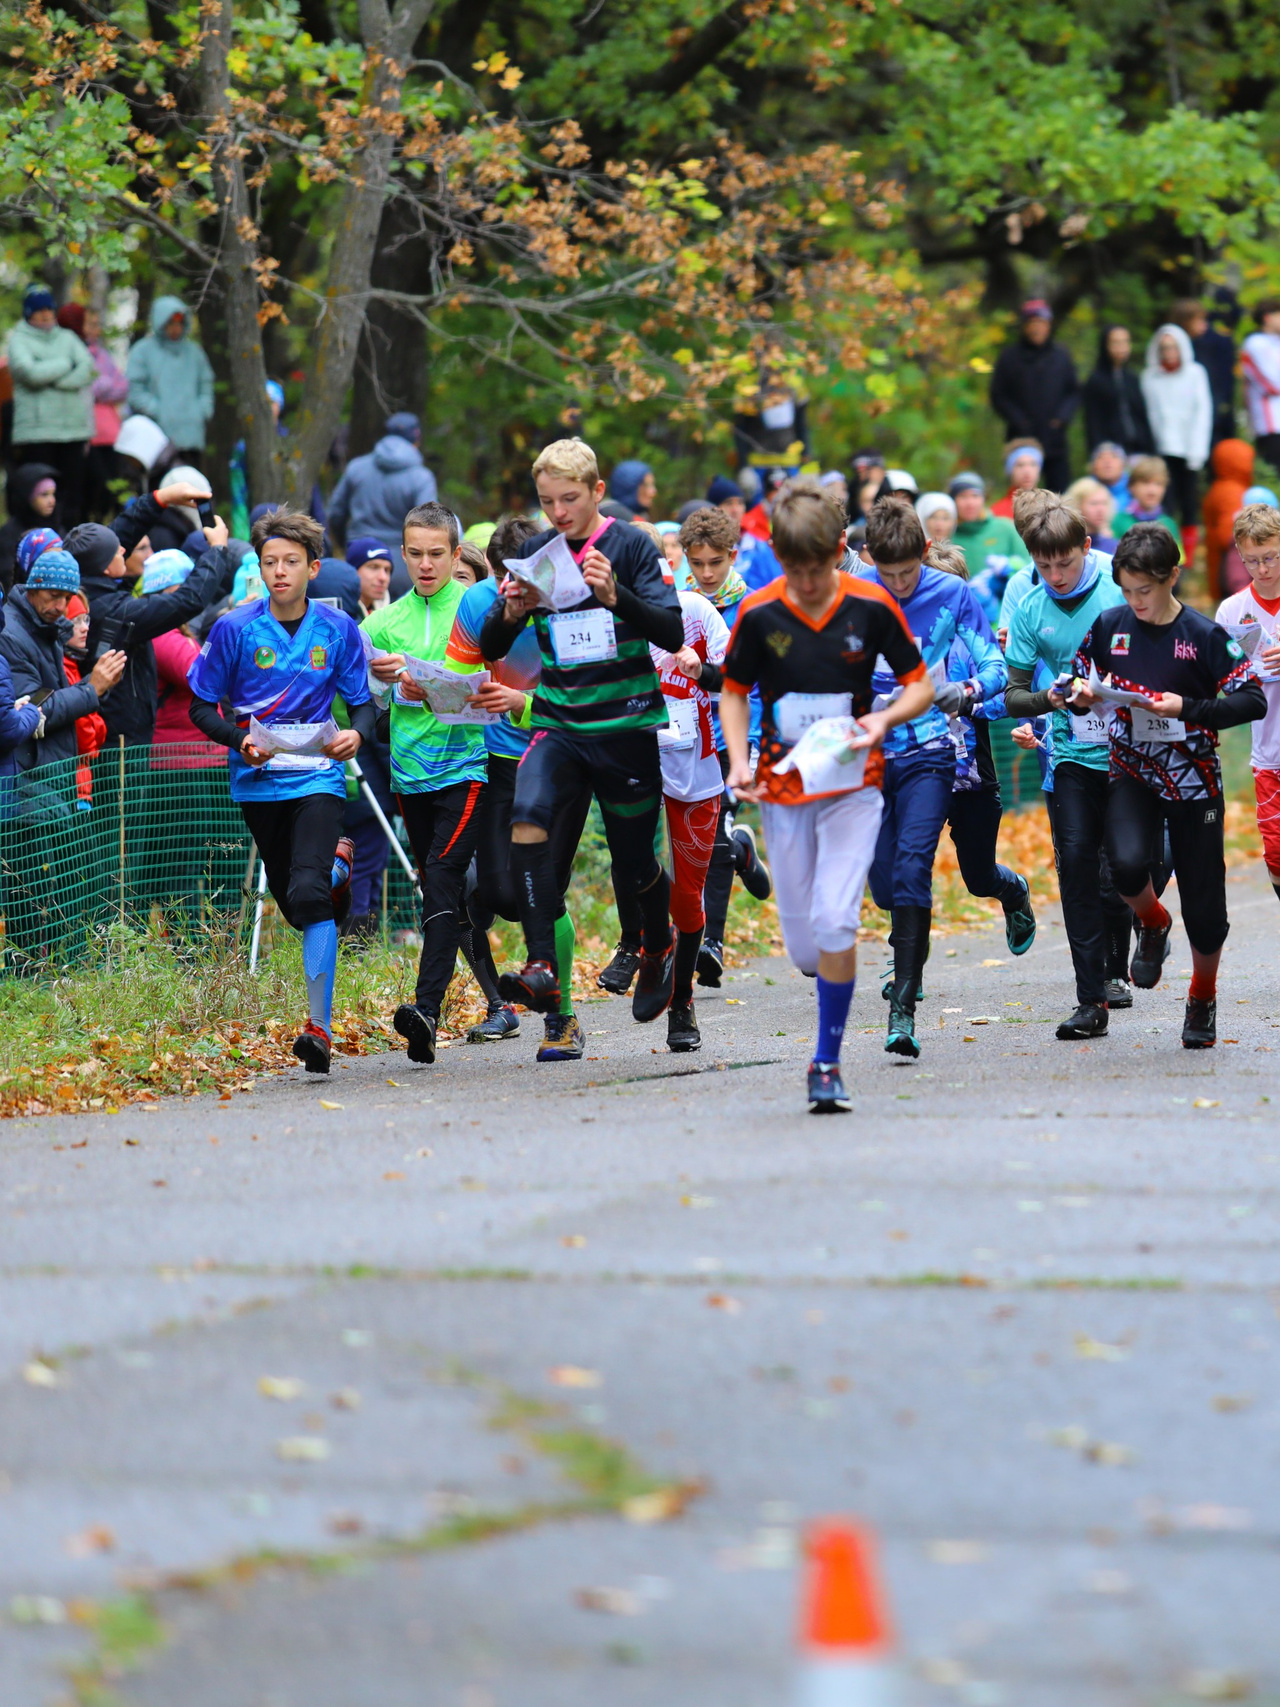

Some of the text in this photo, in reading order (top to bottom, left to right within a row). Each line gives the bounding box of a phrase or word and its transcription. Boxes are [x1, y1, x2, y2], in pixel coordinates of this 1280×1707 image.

[569, 632, 592, 646] 234
[660, 671, 688, 689] Run
[688, 685, 710, 709] and
[1086, 719, 1106, 731] 239
[1147, 719, 1170, 731] 238
